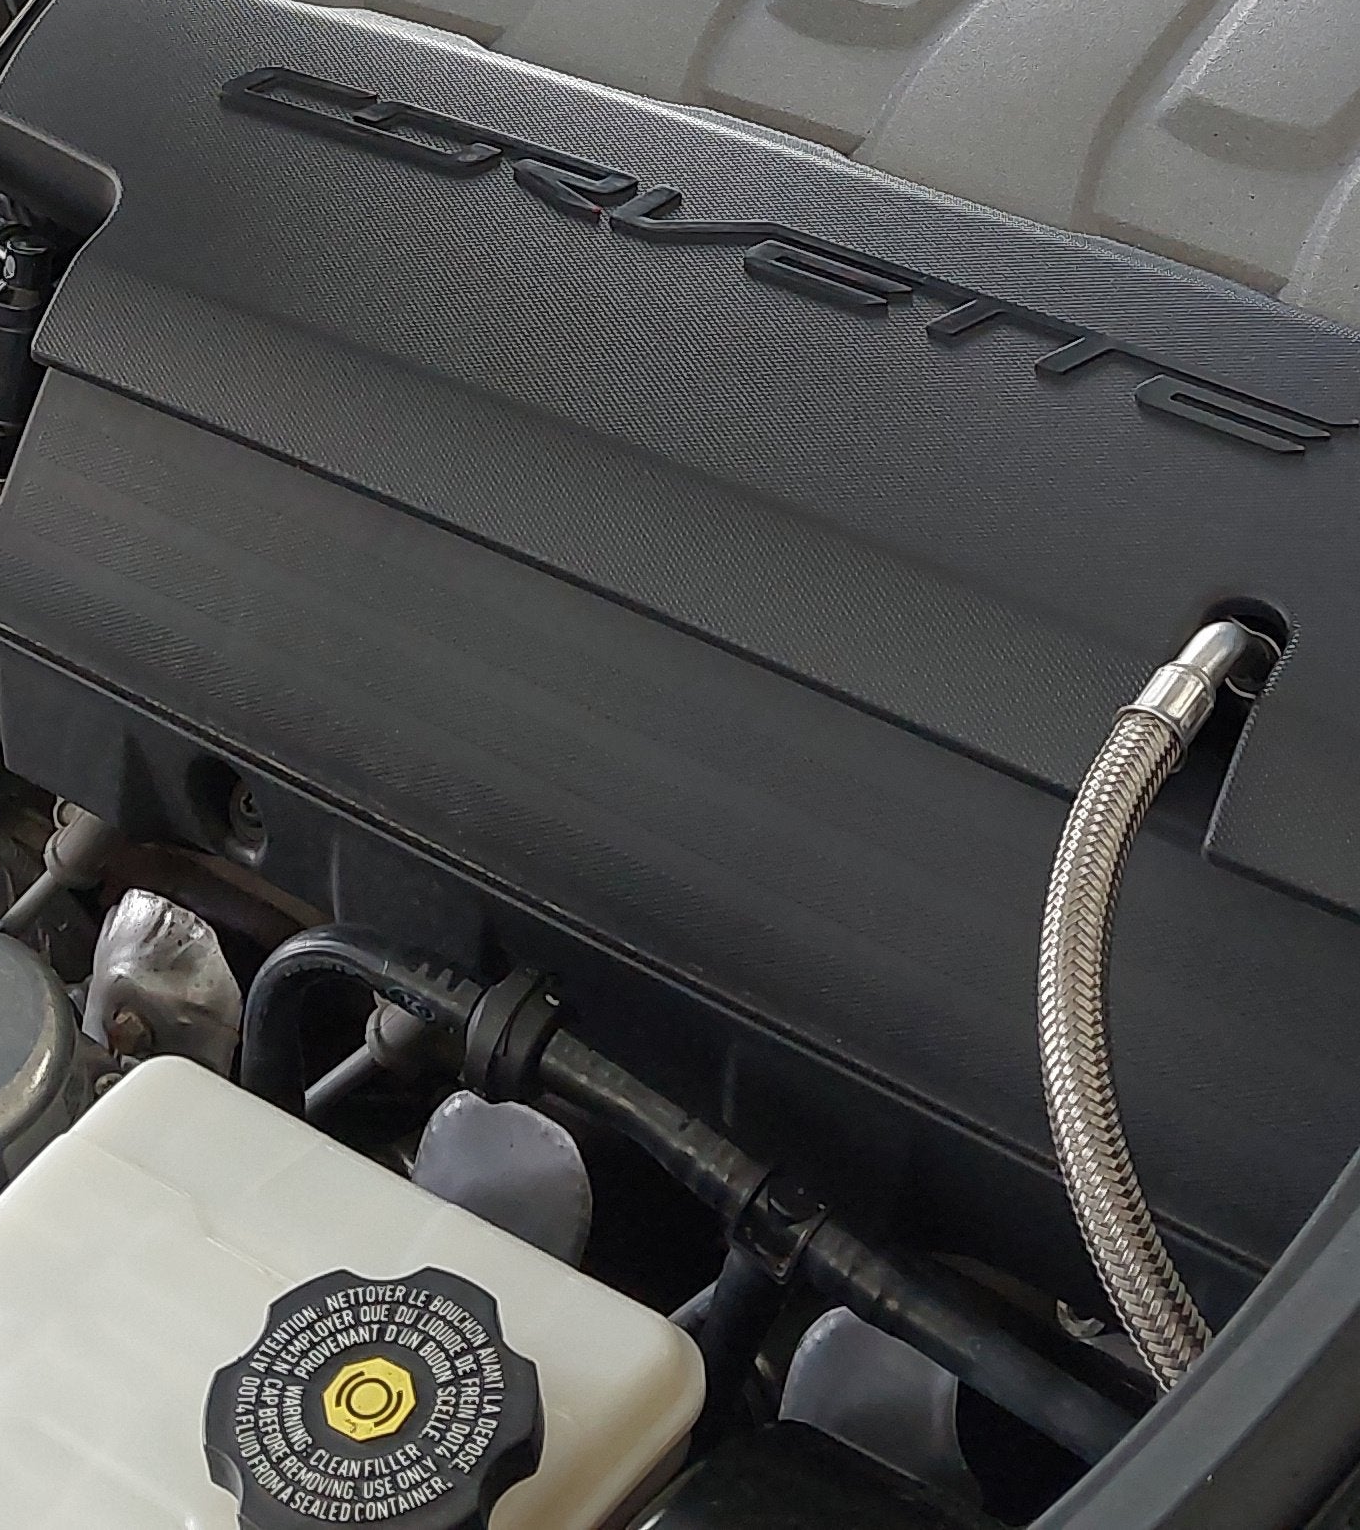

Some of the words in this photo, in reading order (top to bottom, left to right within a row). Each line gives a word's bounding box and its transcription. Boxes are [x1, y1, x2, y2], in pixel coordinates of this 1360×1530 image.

[324, 1285, 407, 1312] NETTOYER
[360, 1304, 390, 1323] QUE
[394, 1304, 420, 1325] DU
[408, 1288, 430, 1308] LE
[249, 1304, 324, 1373] ATTENTION:
[417, 1313, 468, 1358] LIQUIDE
[428, 1295, 490, 1348] BOUCHON
[293, 1324, 381, 1380] PROVENANT
[418, 1340, 456, 1384] BIDON
[453, 1353, 478, 1376] DE
[476, 1346, 505, 1389] AVANT
[260, 1378, 284, 1406] CAP
[455, 1377, 481, 1420] FREIN
[482, 1395, 503, 1414] LA
[235, 1414, 261, 1458] FLUID
[258, 1408, 291, 1463] BEFORE
[282, 1385, 313, 1457] WARNING:
[309, 1448, 361, 1479] CLEAN
[364, 1443, 422, 1477] FILLER
[247, 1453, 286, 1493] FROM
[363, 1476, 396, 1499] USE
[397, 1455, 438, 1489] ONLY
[278, 1484, 295, 1504] A
[290, 1491, 352, 1522] SEALED
[354, 1476, 454, 1522] CONTAINER.
